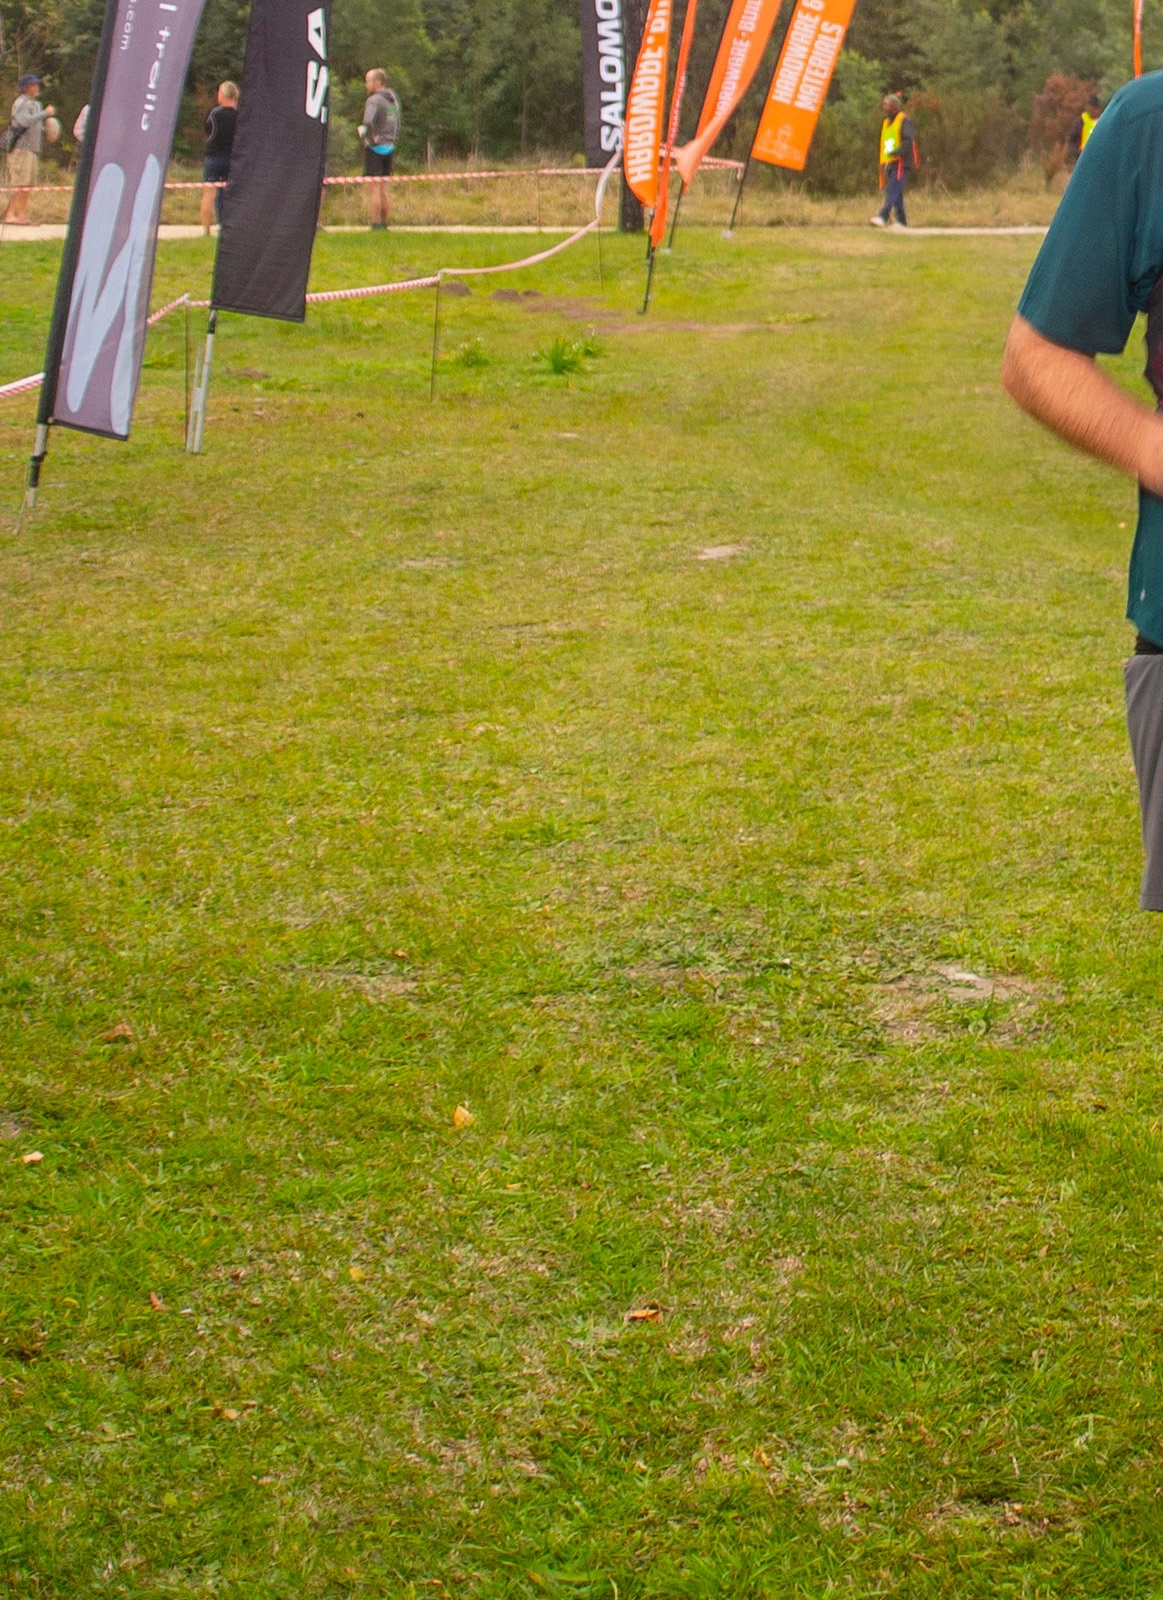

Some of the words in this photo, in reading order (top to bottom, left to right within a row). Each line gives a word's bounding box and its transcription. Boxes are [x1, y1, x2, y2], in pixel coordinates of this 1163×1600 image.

[141, 26, 172, 131] trails
[772, 8, 822, 105] HARDWARE
[794, 20, 845, 111] MATERIALS
